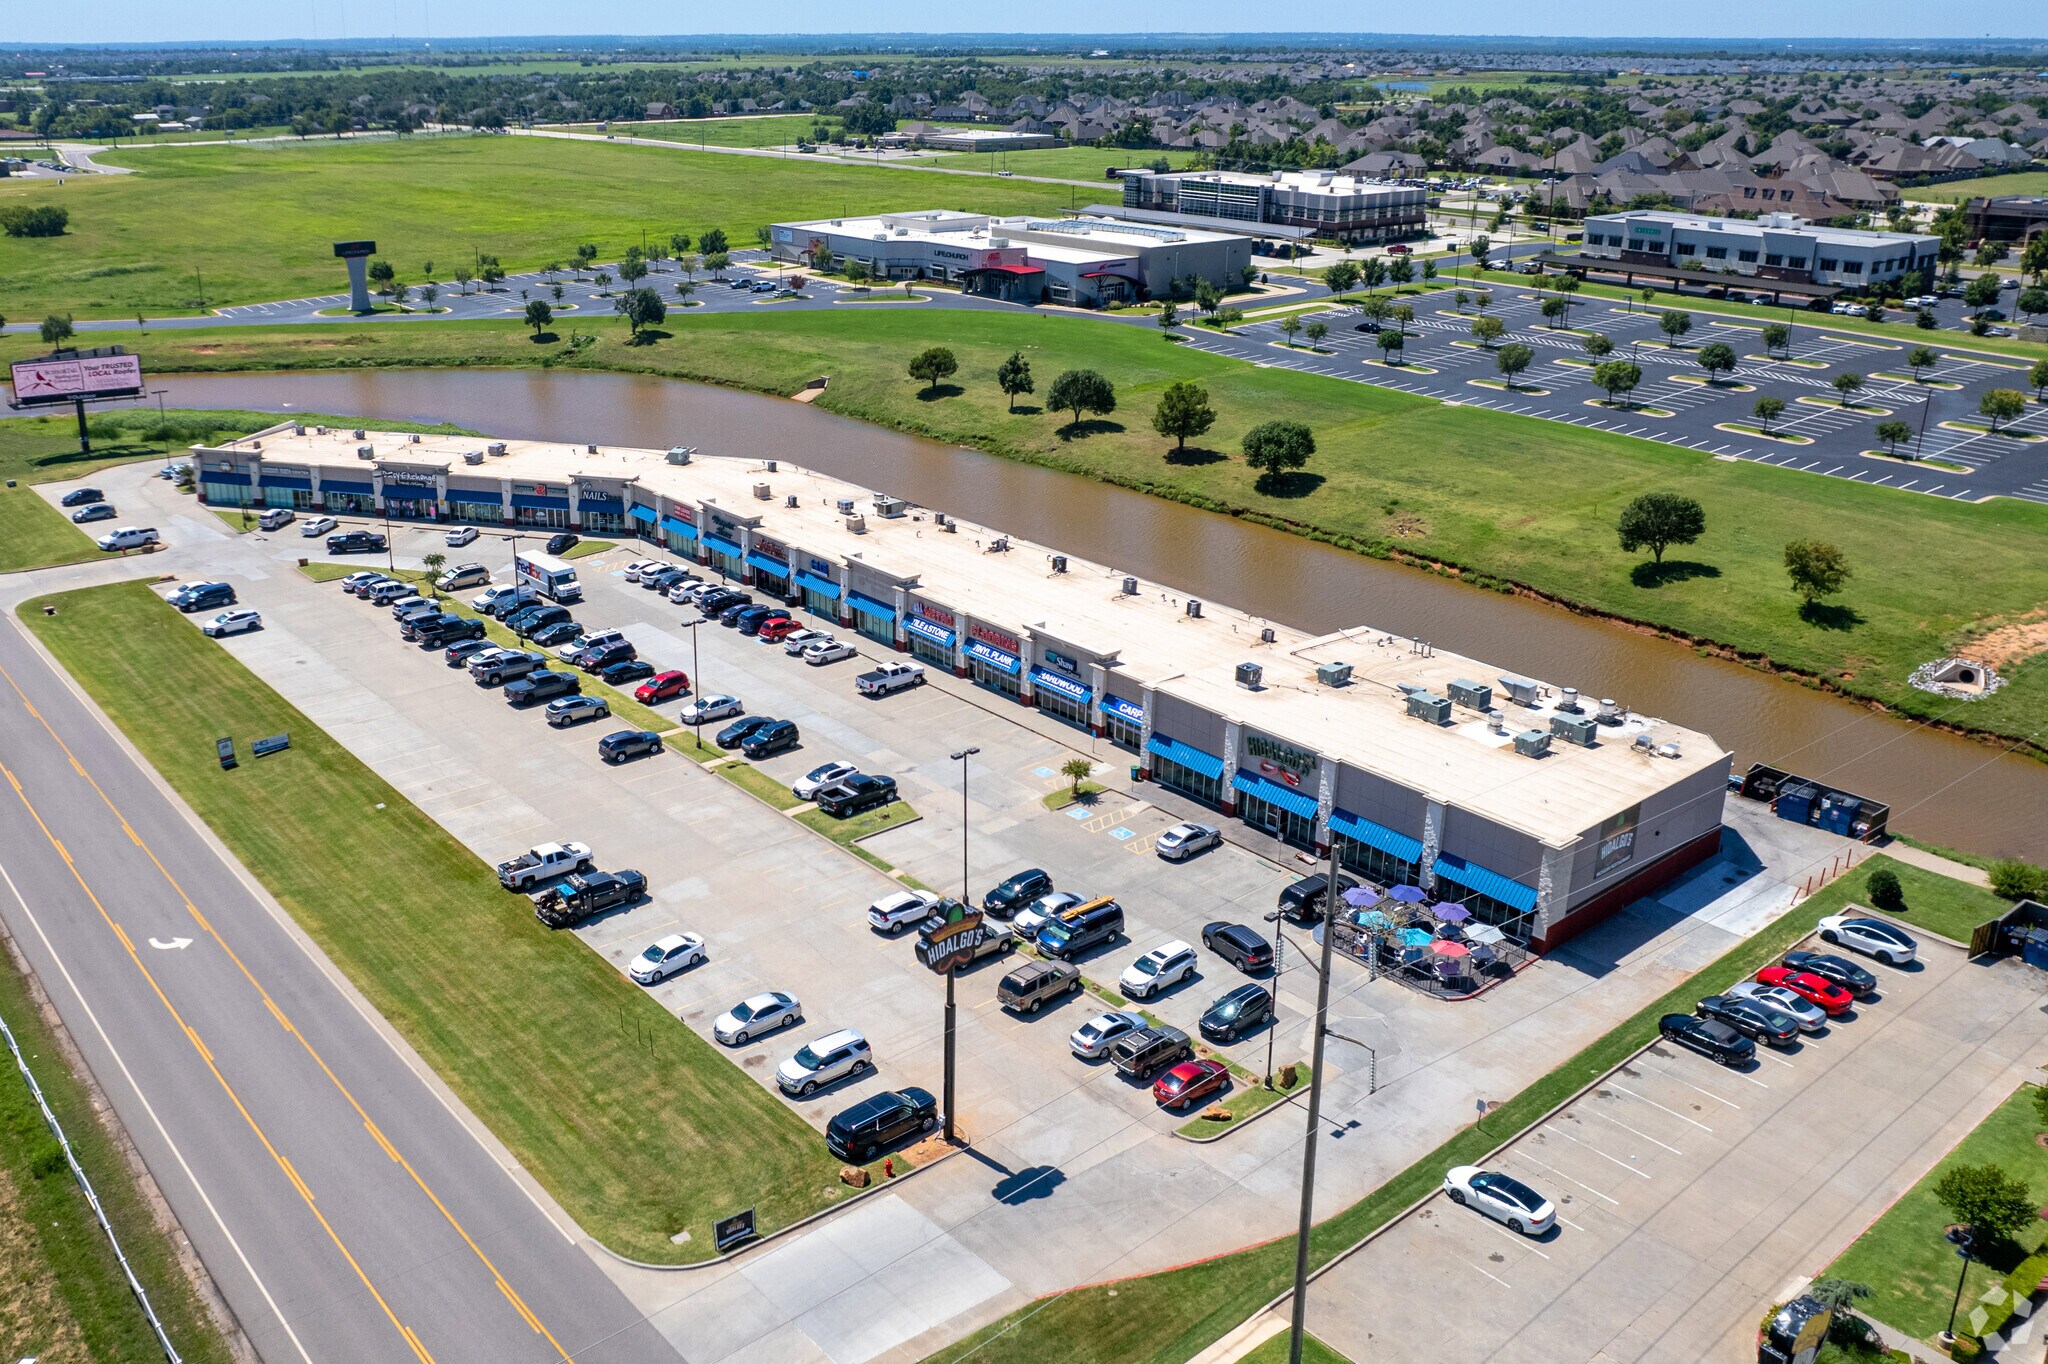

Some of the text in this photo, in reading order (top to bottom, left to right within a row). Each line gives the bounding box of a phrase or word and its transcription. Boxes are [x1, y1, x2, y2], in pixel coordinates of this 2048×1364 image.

[101, 361, 134, 370] TRUSTED
[88, 370, 111, 378] LOCAL
[583, 490, 608, 501] NAILS
[923, 606, 954, 626] METRO
[928, 624, 951, 639] STONE
[971, 624, 1019, 654] FLOORING
[990, 650, 1015, 667] PLANK
[1056, 656, 1075, 671] Shaw
[1038, 671, 1085, 695] HARDWOOD
[1118, 703, 1144, 719] CARP
[927, 928, 984, 965] HIDALGO'S
